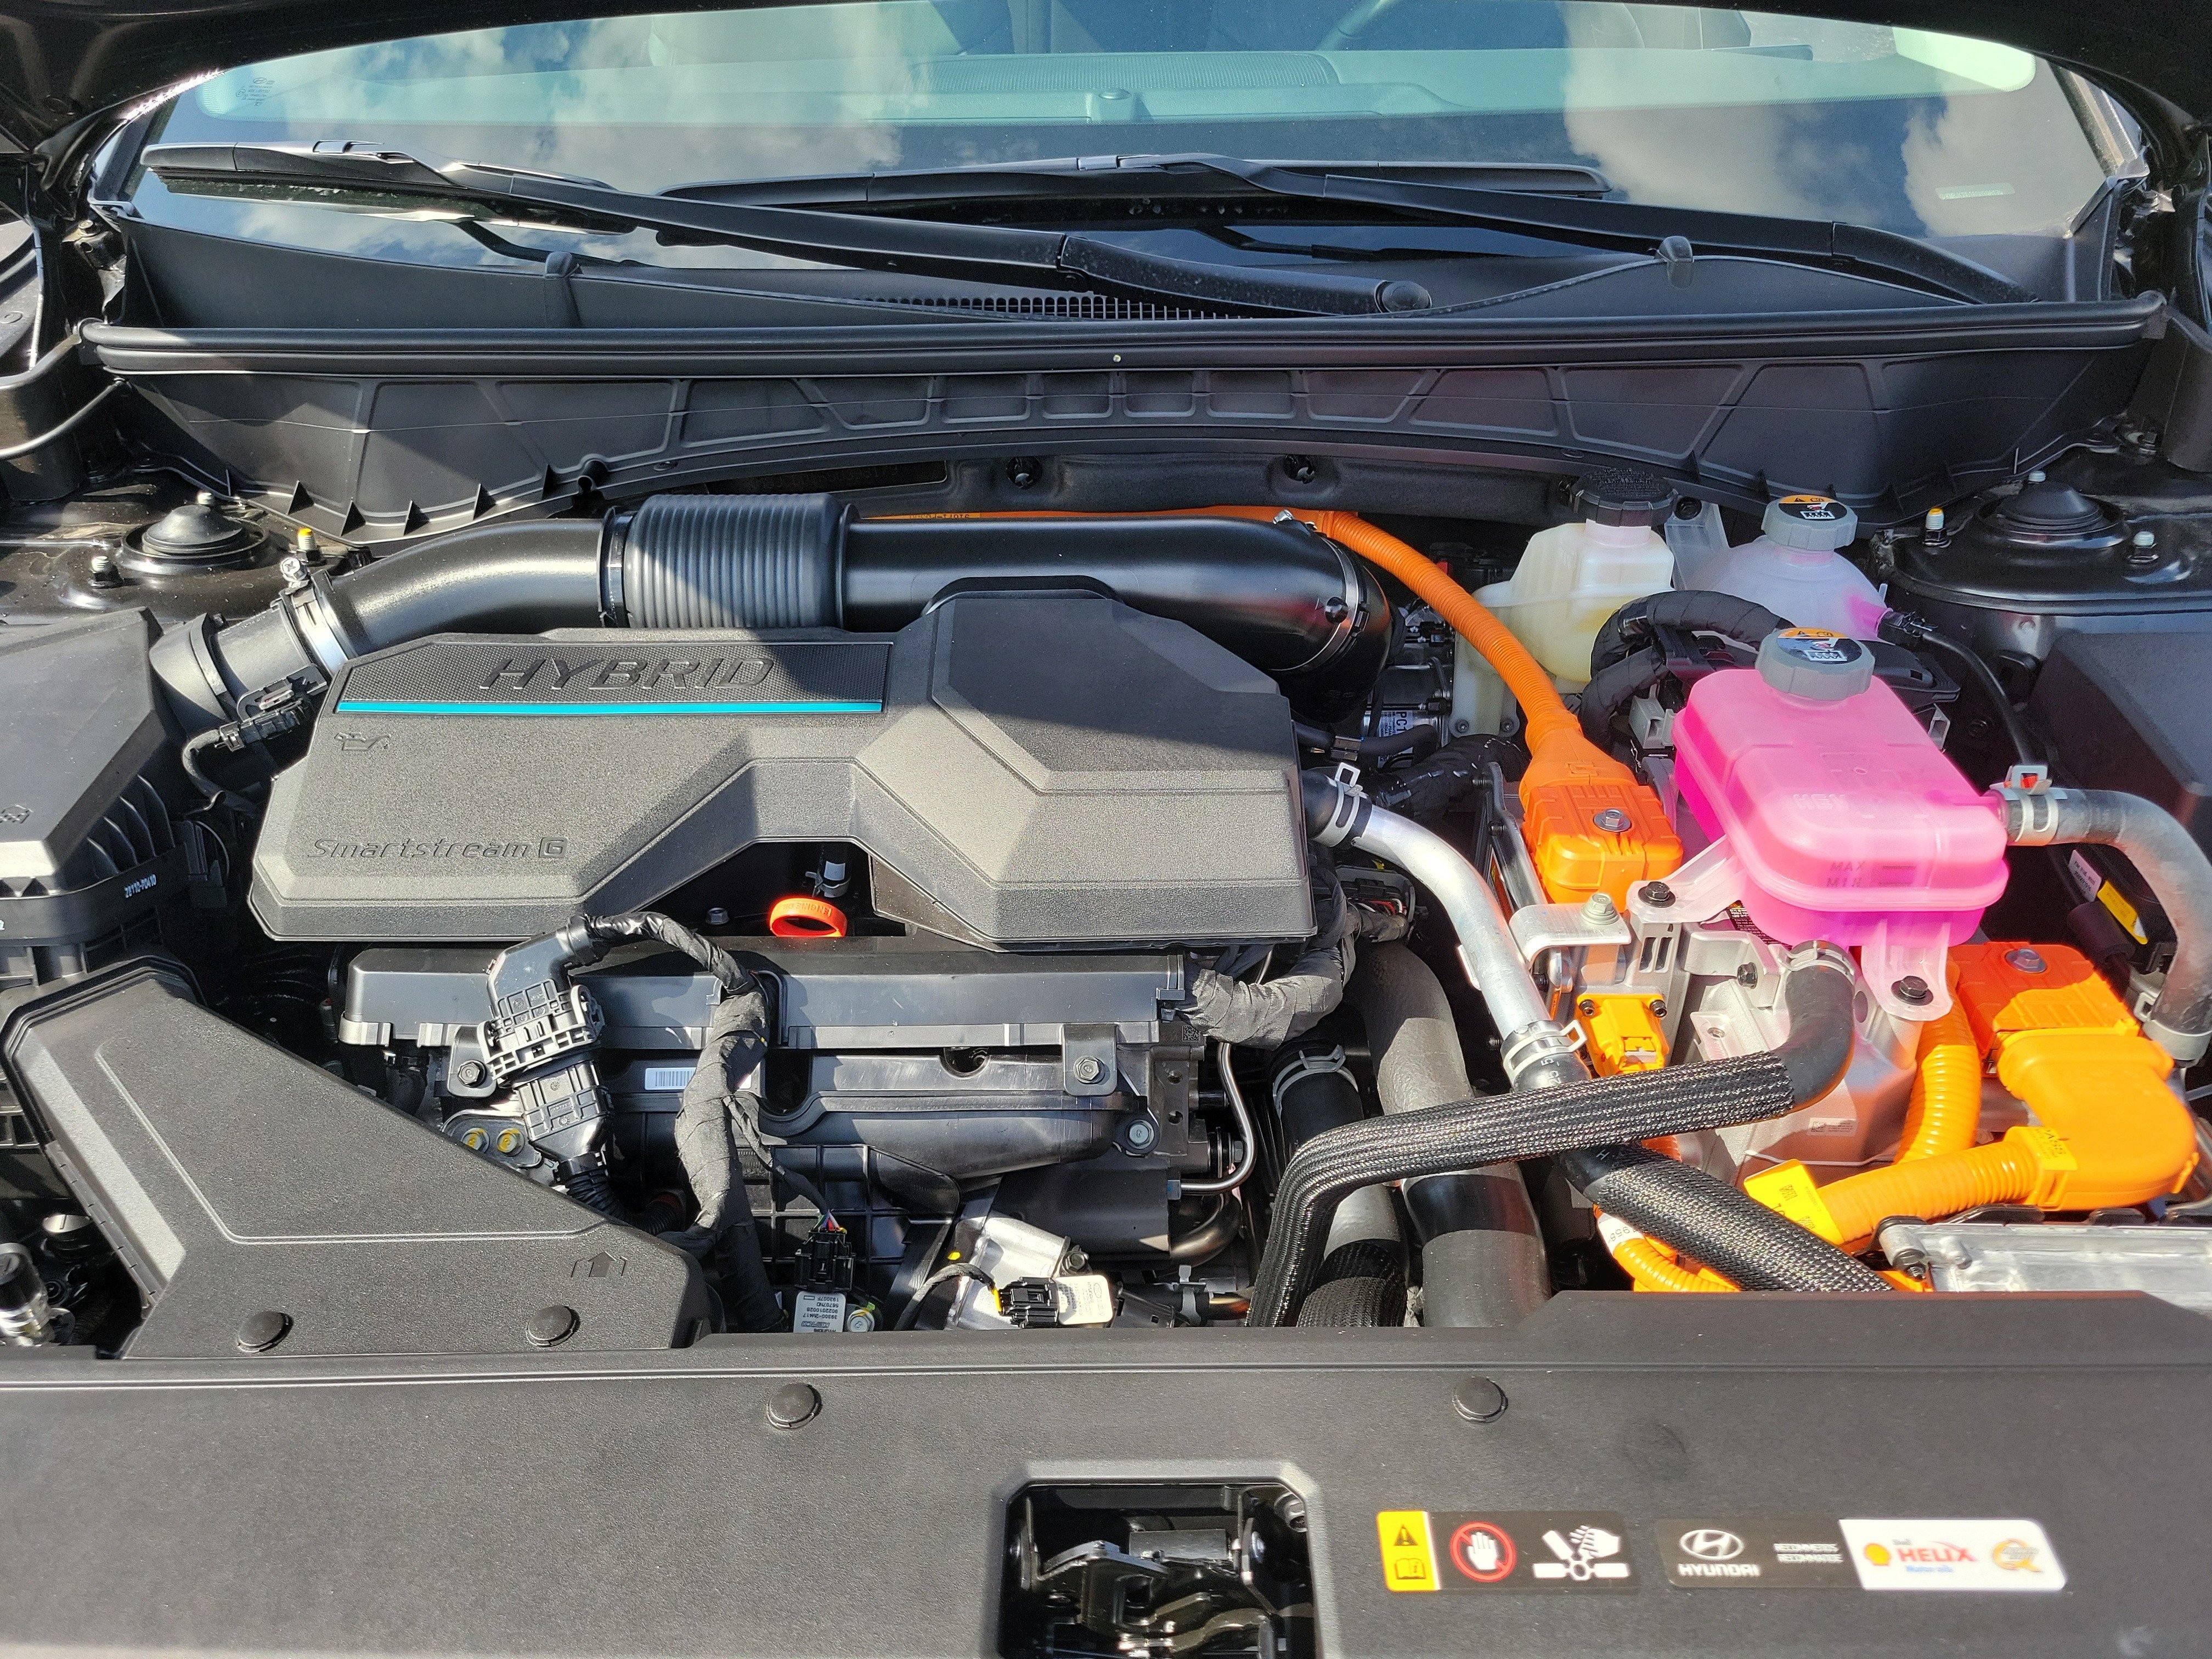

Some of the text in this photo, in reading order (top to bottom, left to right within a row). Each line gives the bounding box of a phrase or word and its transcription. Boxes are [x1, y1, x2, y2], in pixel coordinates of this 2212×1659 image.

[479, 658, 774, 690] HYBRID
[308, 837, 569, 858] Smartstream G
[1830, 861, 1865, 871] MAX
[1897, 1547, 1977, 1562] HELIX
[1678, 1563, 1761, 1576] HYUNDAI
